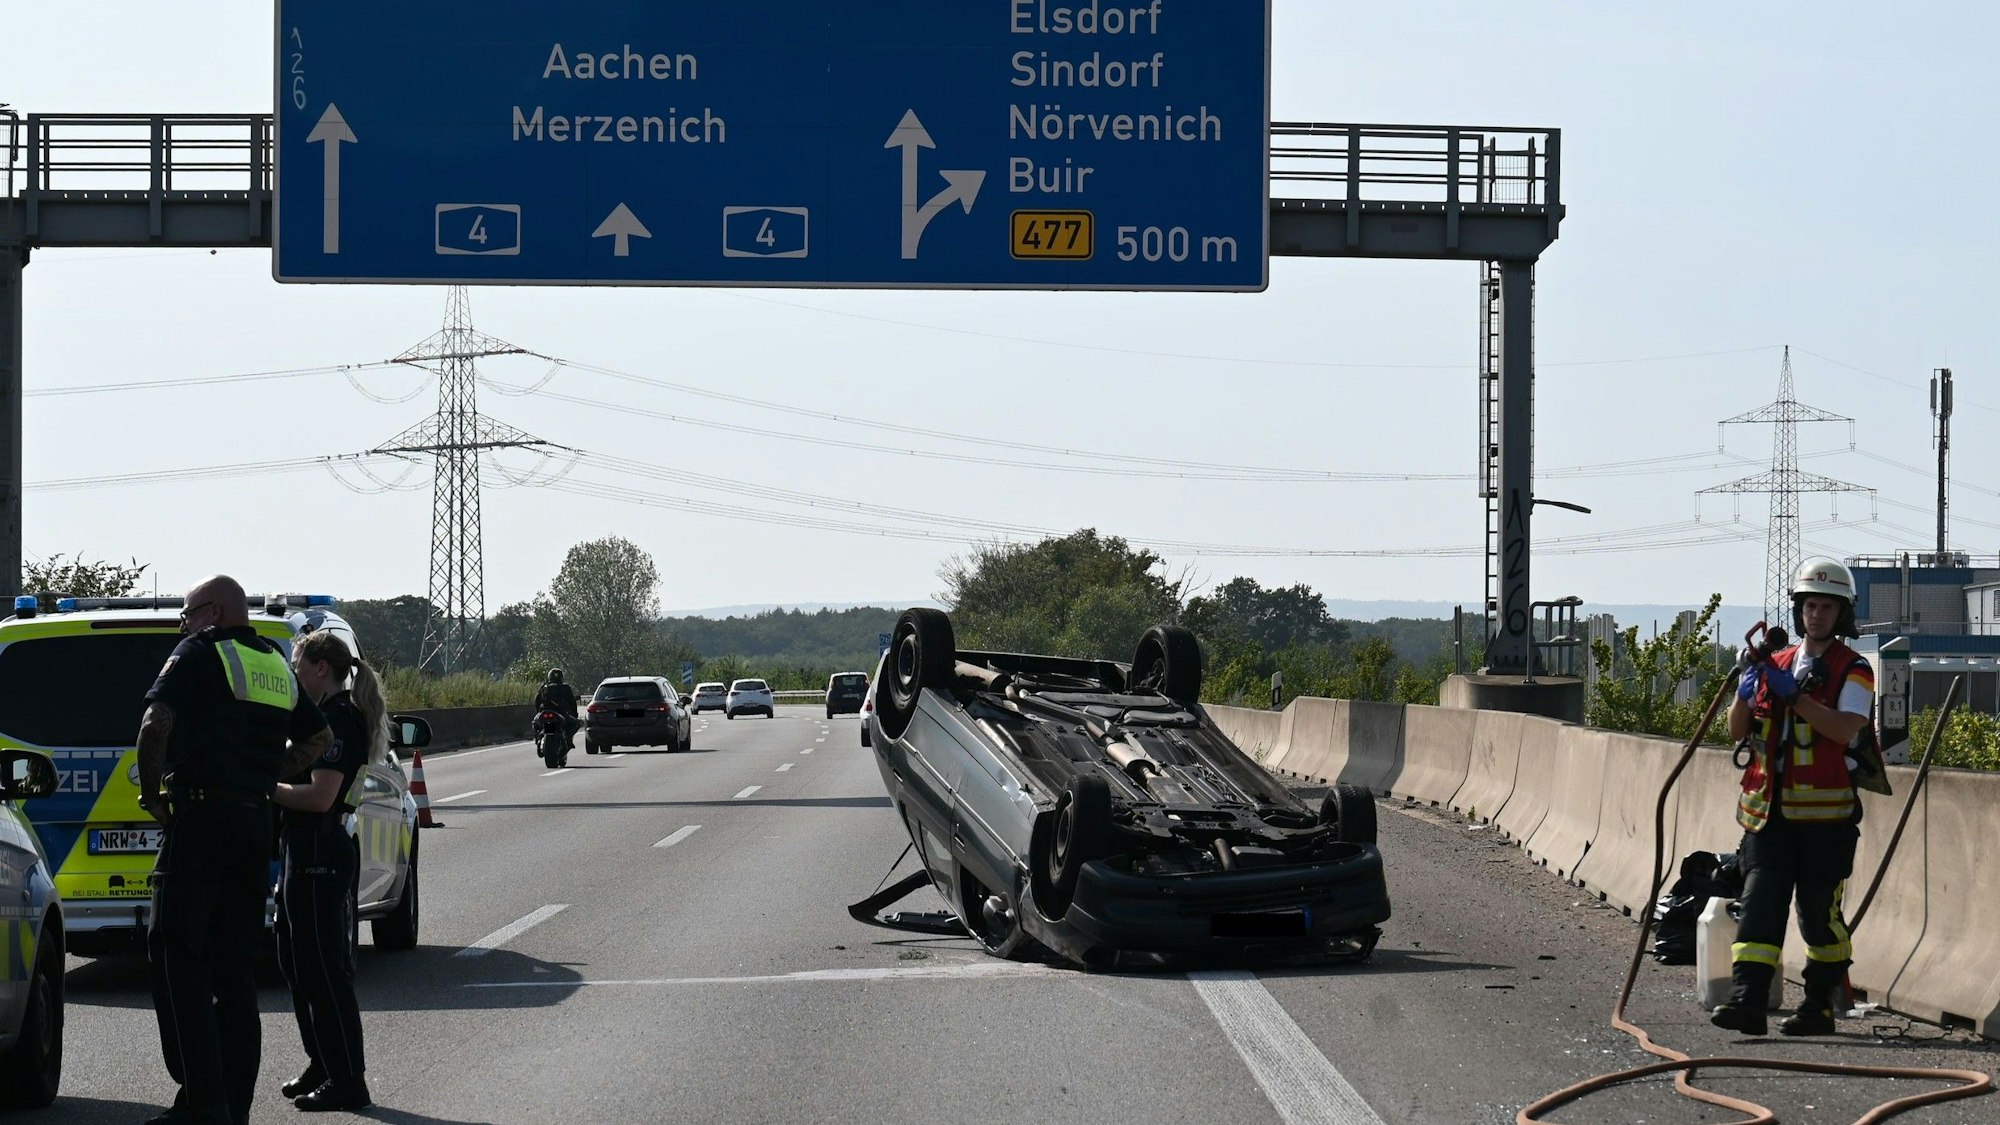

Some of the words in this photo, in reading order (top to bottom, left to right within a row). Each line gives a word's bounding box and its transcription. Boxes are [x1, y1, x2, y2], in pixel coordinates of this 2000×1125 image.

[1010, 0, 1162, 34] Elsdorf
[542, 43, 698, 80] Aachen
[1010, 50, 1164, 88] Sindorf
[512, 105, 727, 144] Merzenich
[1008, 104, 1222, 141] Nörvenich
[1008, 157, 1095, 193] Buir
[467, 214, 488, 245] 4
[755, 217, 776, 247] 4
[1021, 219, 1082, 251] 477
[1116, 226, 1190, 263] 500
[1201, 235, 1238, 263] m
[1815, 571, 1827, 582] 10
[251, 671, 288, 696] POLIZEI
[99, 832, 129, 849] NRW
